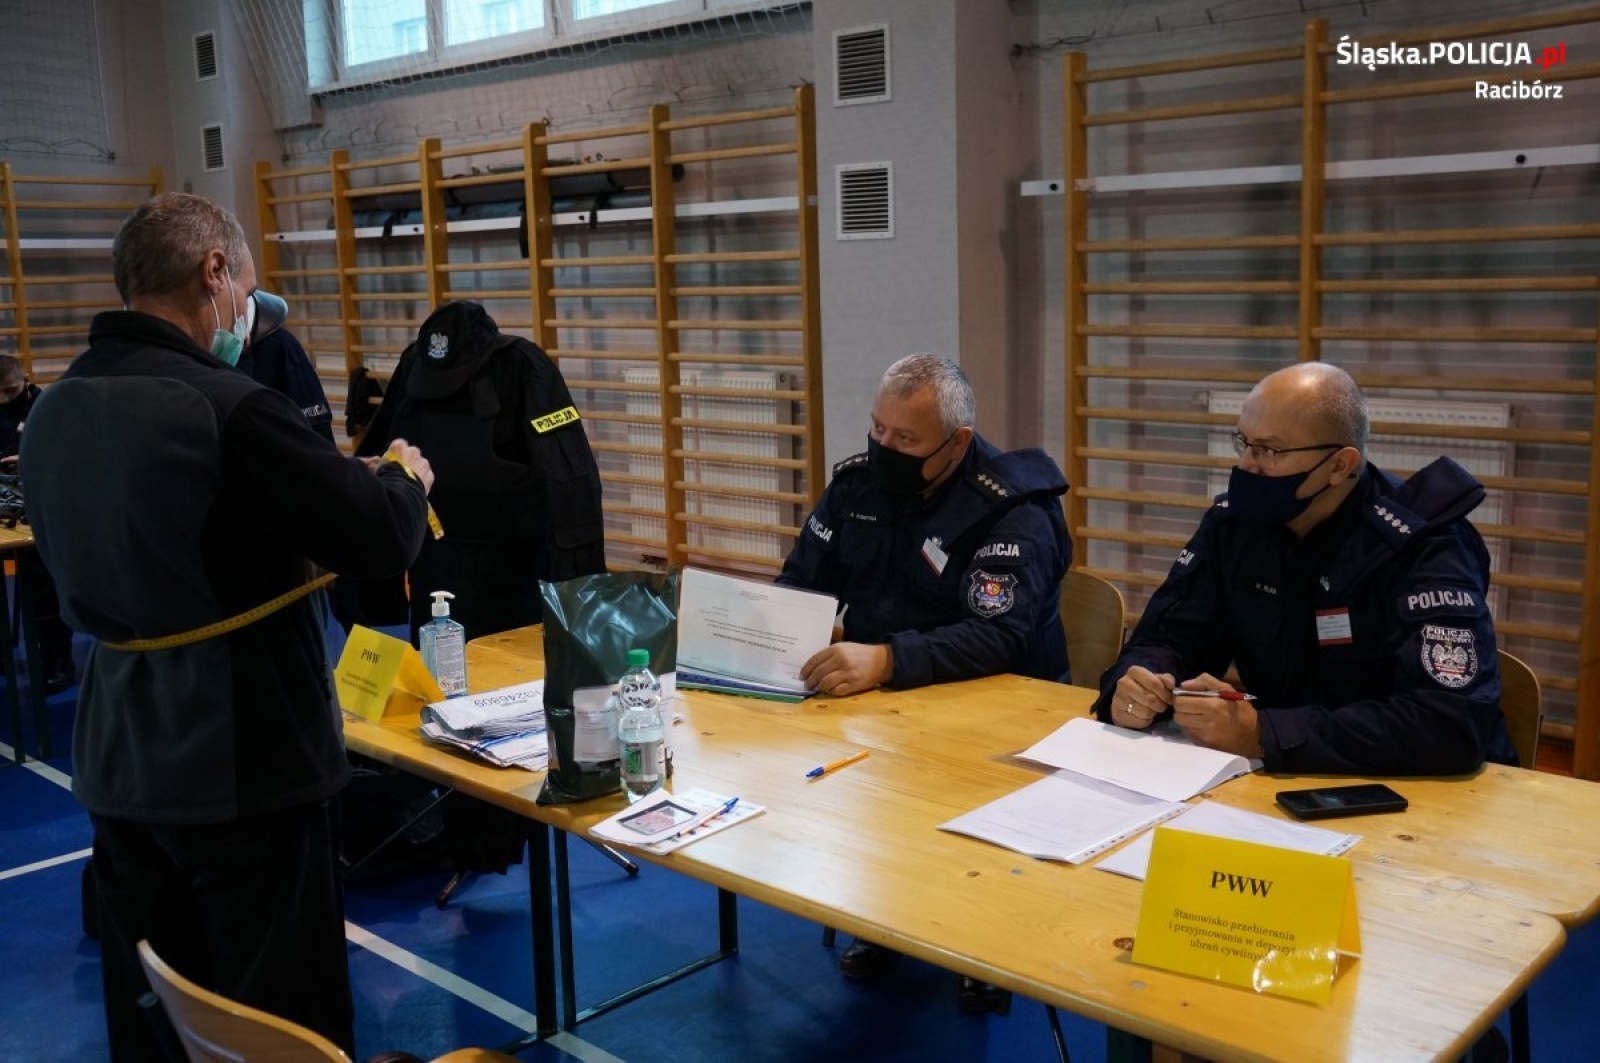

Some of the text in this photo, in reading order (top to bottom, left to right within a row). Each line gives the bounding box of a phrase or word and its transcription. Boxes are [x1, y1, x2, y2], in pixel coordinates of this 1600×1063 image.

[536, 410, 575, 428] POLICJA
[973, 543, 1020, 559] POLICJA
[1407, 590, 1475, 610] POLICJA
[360, 649, 381, 664] PWW
[1211, 870, 1274, 898] PWW
[1173, 908, 1295, 941] Stanowisko przebierania
[1174, 923, 1242, 944] przyjmowania
[1245, 938, 1254, 946] w
[1255, 938, 1296, 956] depozyt
[1190, 939, 1218, 952] ubrań
